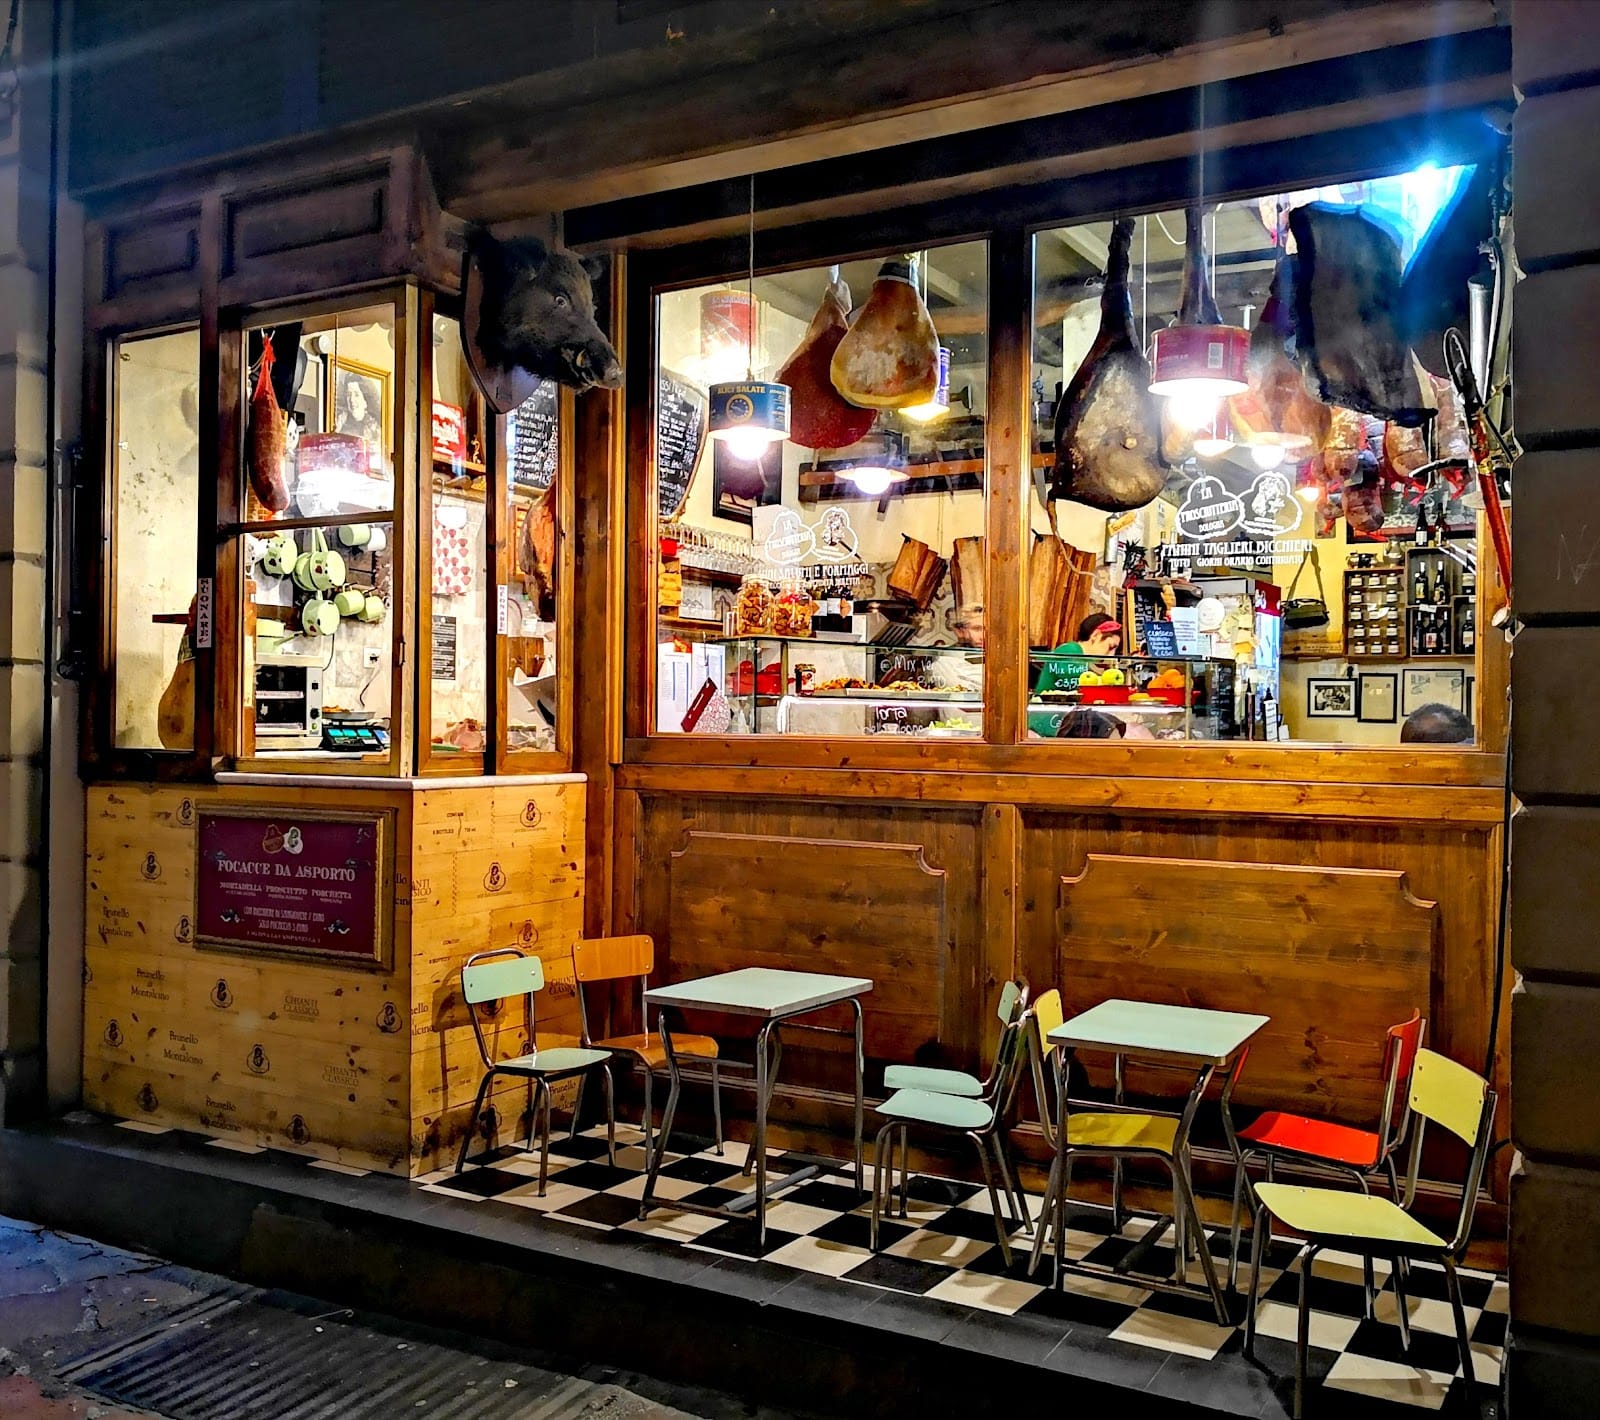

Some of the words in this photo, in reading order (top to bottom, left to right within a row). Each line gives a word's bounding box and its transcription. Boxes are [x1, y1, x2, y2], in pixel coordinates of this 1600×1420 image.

[1201, 487, 1213, 500] LA
[823, 563, 869, 577] FORMAGGI
[1049, 662, 1065, 674] Mix
[217, 859, 271, 876] FOCACCE
[275, 863, 291, 877] DA
[296, 866, 356, 882] ASPORTO
